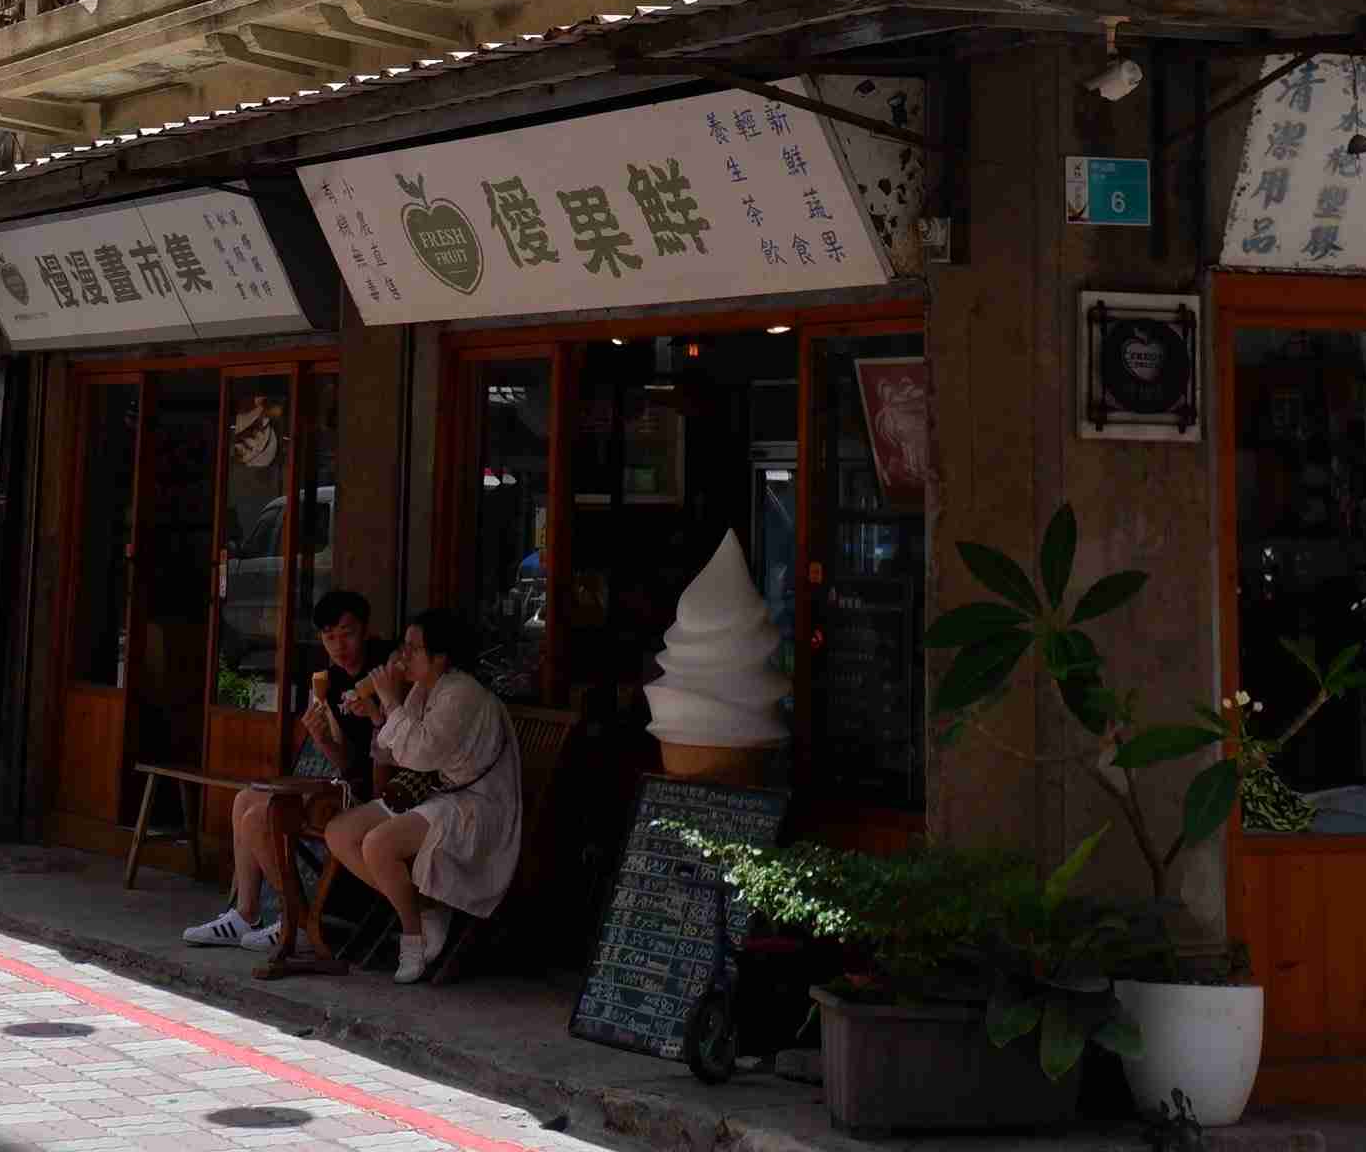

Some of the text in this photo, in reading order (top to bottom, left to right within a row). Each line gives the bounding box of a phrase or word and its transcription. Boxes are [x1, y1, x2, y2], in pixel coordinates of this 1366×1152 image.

[1111, 191, 1125, 214] 6
[418, 227, 468, 249] FRESH
[434, 248, 468, 266] FRUIT
